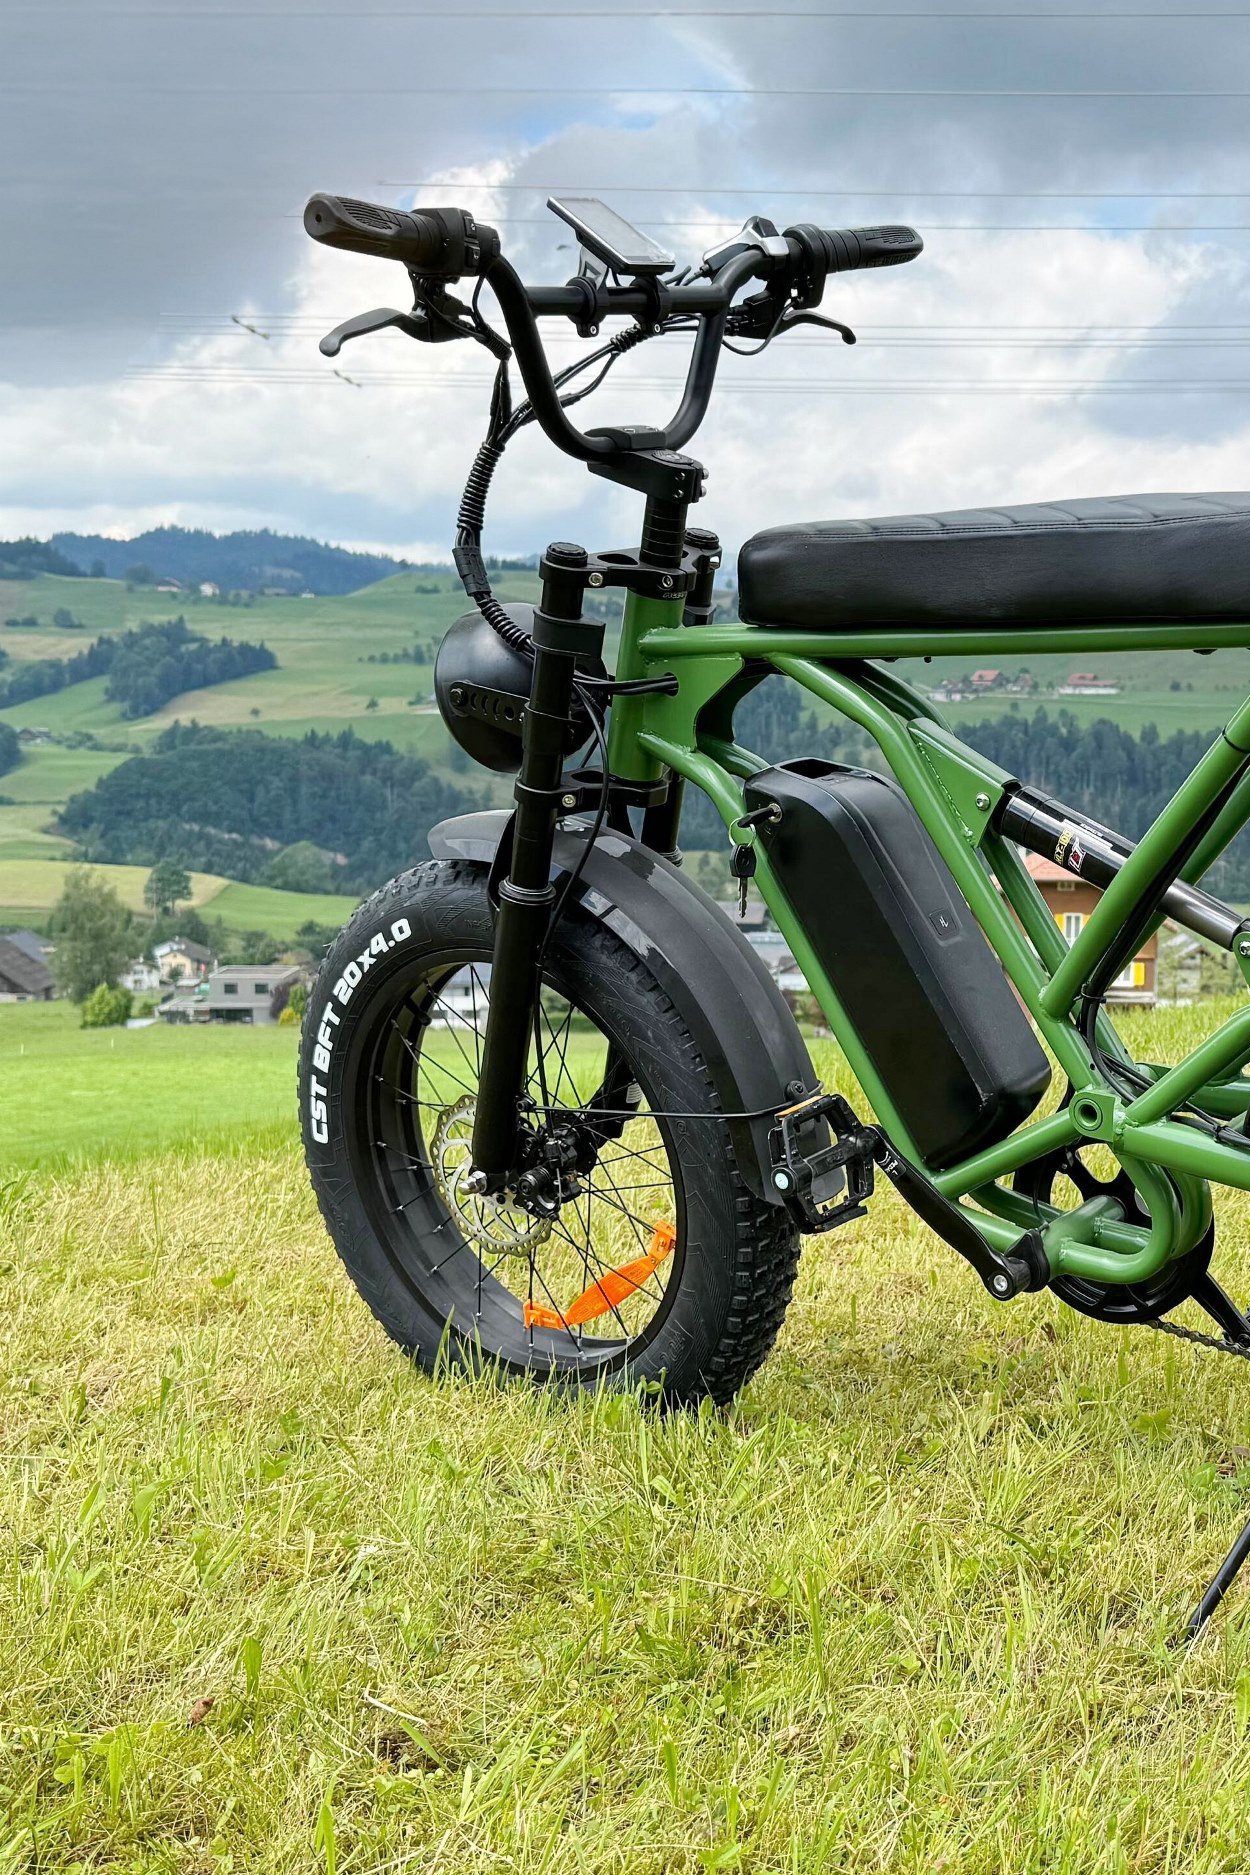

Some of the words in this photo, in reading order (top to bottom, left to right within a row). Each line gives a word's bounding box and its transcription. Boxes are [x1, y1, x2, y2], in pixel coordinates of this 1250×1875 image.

[332, 918, 412, 1006] 20x4.0
[312, 1002, 341, 1074] BFT
[310, 1074, 329, 1144] CST
